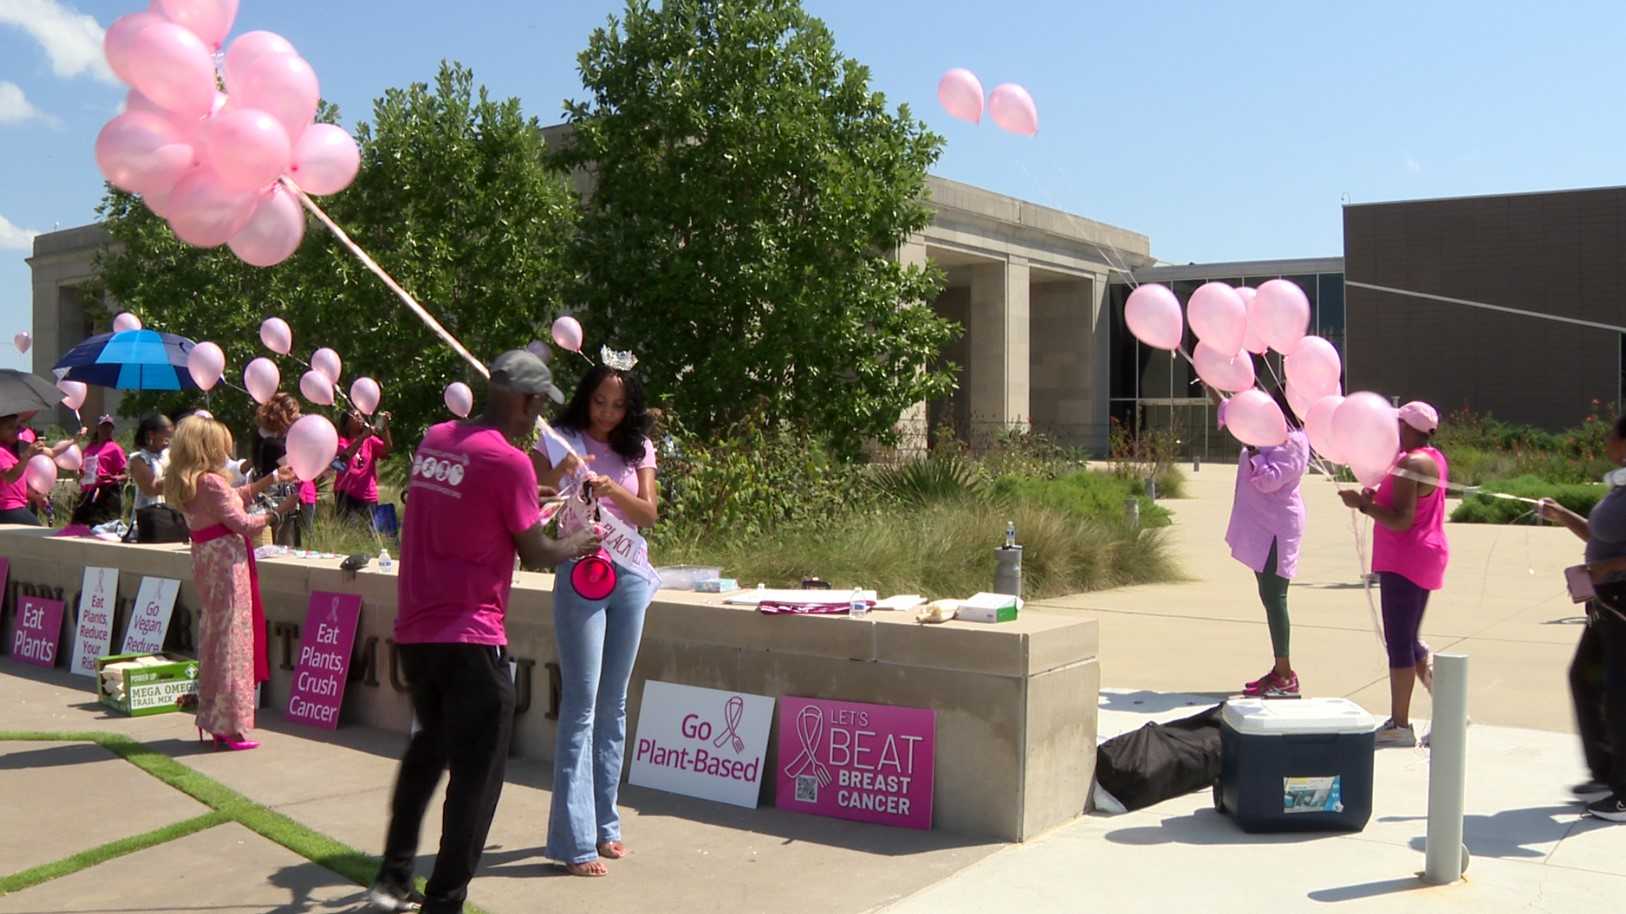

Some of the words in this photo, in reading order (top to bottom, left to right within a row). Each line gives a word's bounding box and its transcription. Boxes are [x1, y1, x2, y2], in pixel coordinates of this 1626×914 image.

[92, 596, 104, 608] Eat
[146, 601, 160, 616] Go
[23, 603, 44, 630] Eat
[80, 625, 108, 641] Reduce
[316, 623, 340, 644] Eat
[14, 630, 54, 663] Plants
[83, 641, 102, 655] Your
[300, 646, 344, 673] Plants,
[132, 686, 161, 698] MEGA
[297, 672, 337, 697] Crush
[132, 697, 156, 707] TRAIL
[158, 695, 173, 704] MIX
[289, 696, 337, 723] Cancer
[681, 714, 712, 741] Go
[636, 738, 760, 783] Plant-Based
[829, 727, 923, 774] BEAT
[839, 770, 911, 794] BREAST
[838, 790, 910, 816] CANCER
